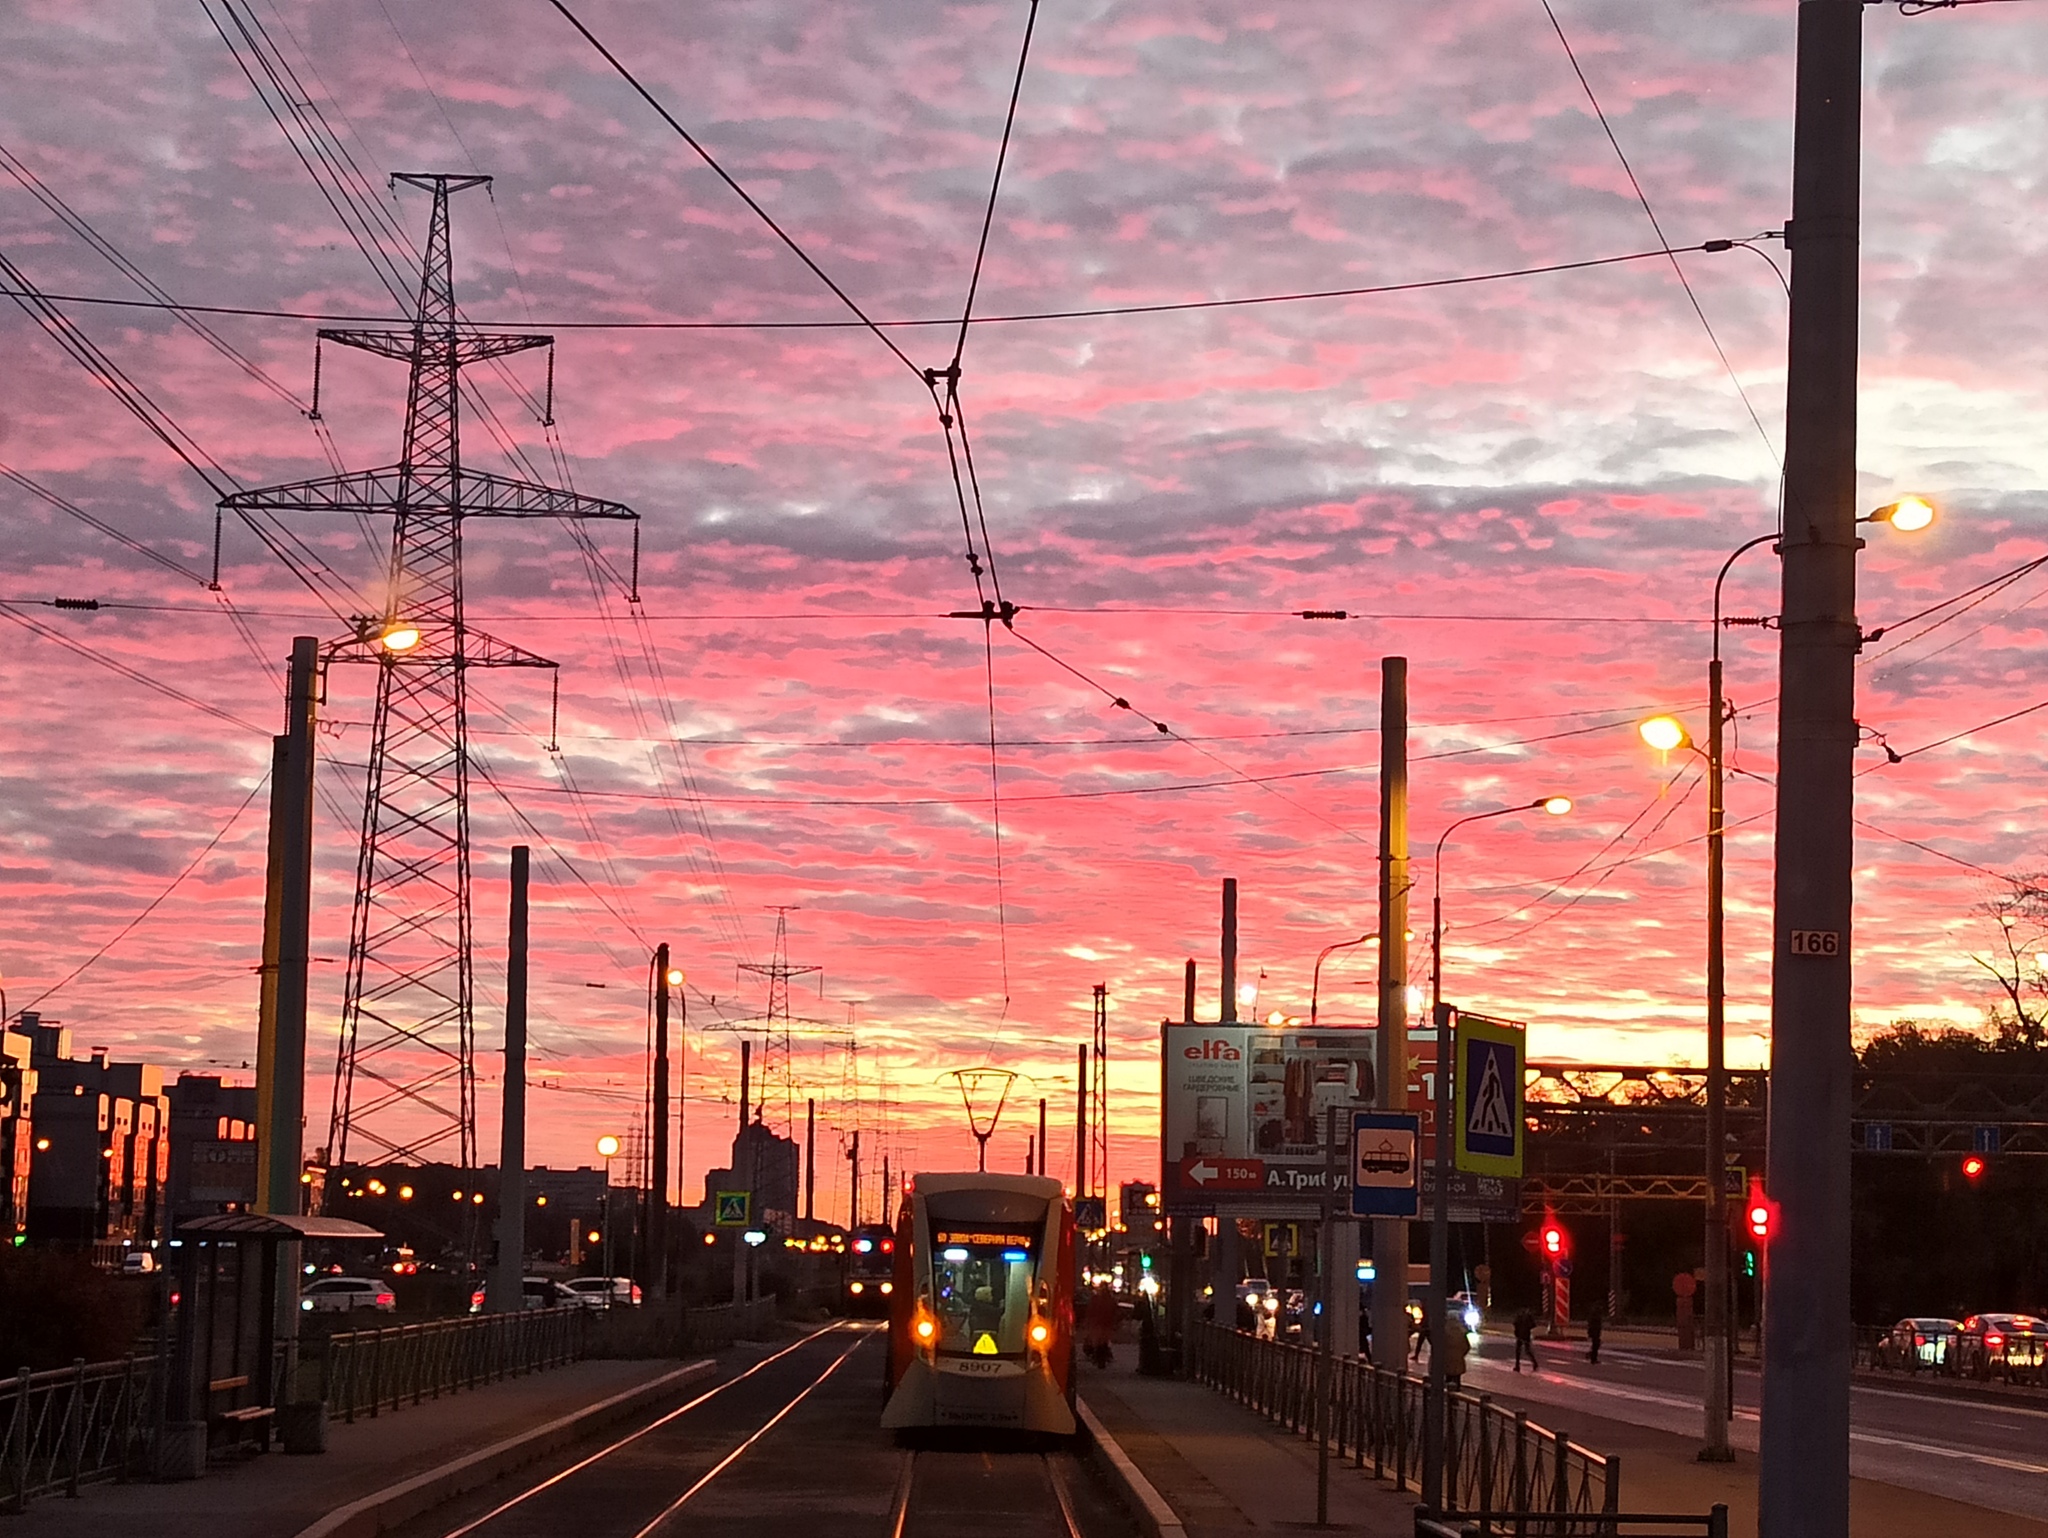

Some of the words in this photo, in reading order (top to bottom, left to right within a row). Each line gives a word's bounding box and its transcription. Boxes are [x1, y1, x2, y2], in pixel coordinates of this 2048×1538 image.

[1794, 932, 1836, 953] 166
[1184, 1039, 1240, 1060] elfa
[958, 1361, 1002, 1374] 8907
